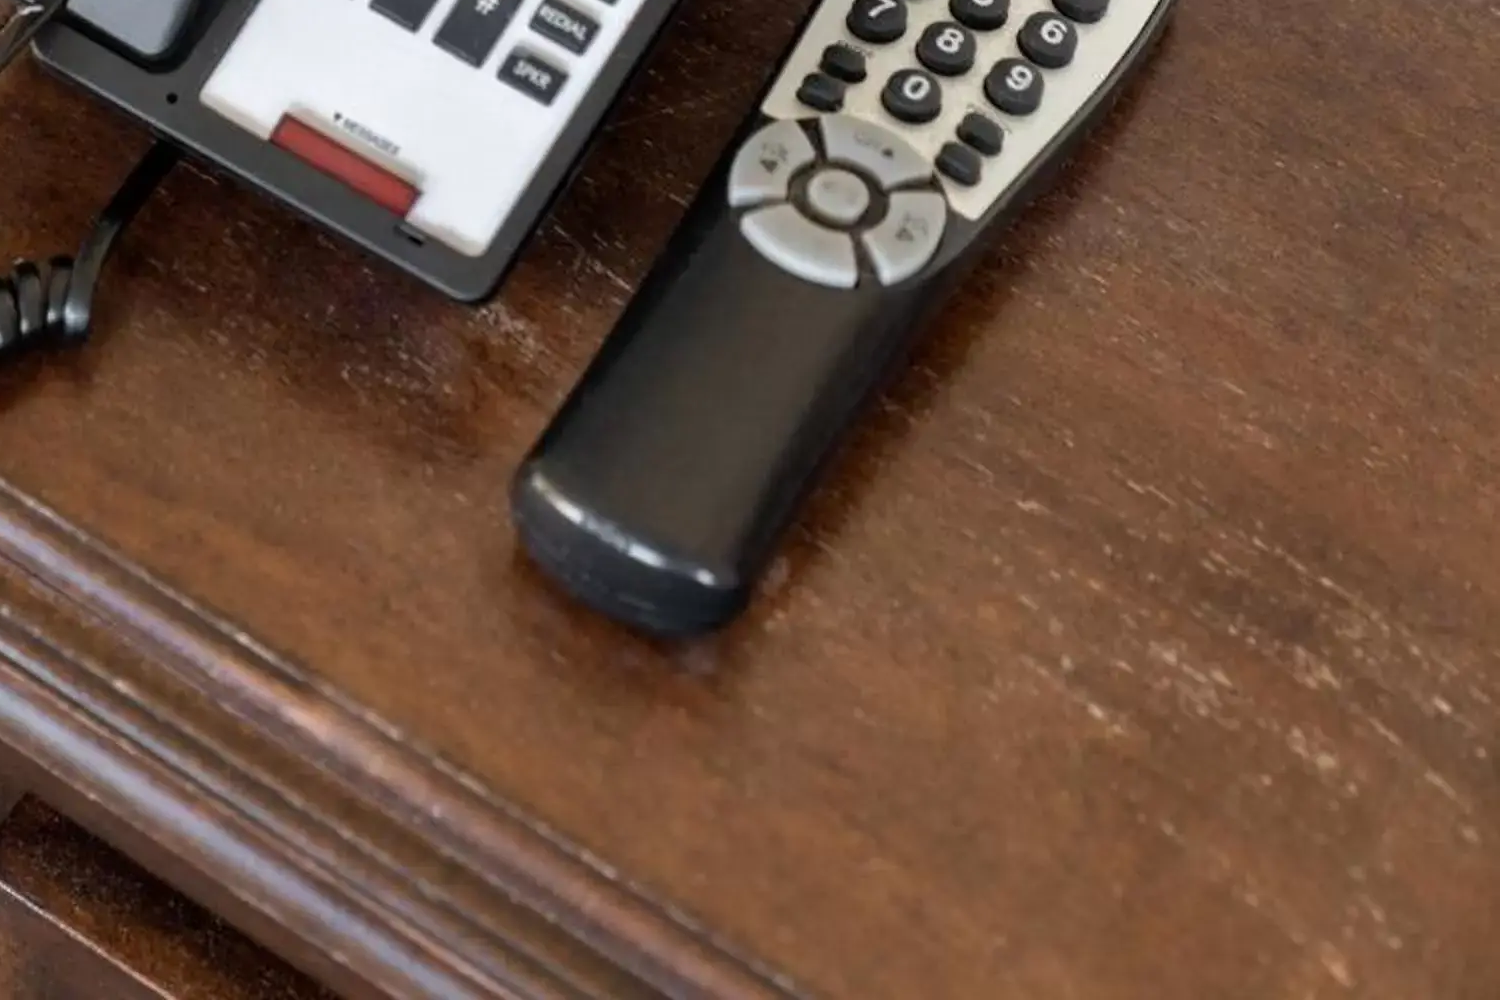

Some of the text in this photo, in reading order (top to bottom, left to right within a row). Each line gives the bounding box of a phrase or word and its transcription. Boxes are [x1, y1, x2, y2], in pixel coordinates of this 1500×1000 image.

[538, 5, 588, 41] REDIAL
[1040, 19, 1068, 45] 6
[935, 28, 965, 54] 8
[512, 59, 552, 90] SPKR
[1005, 65, 1033, 91] 9
[902, 75, 931, 101] 0
